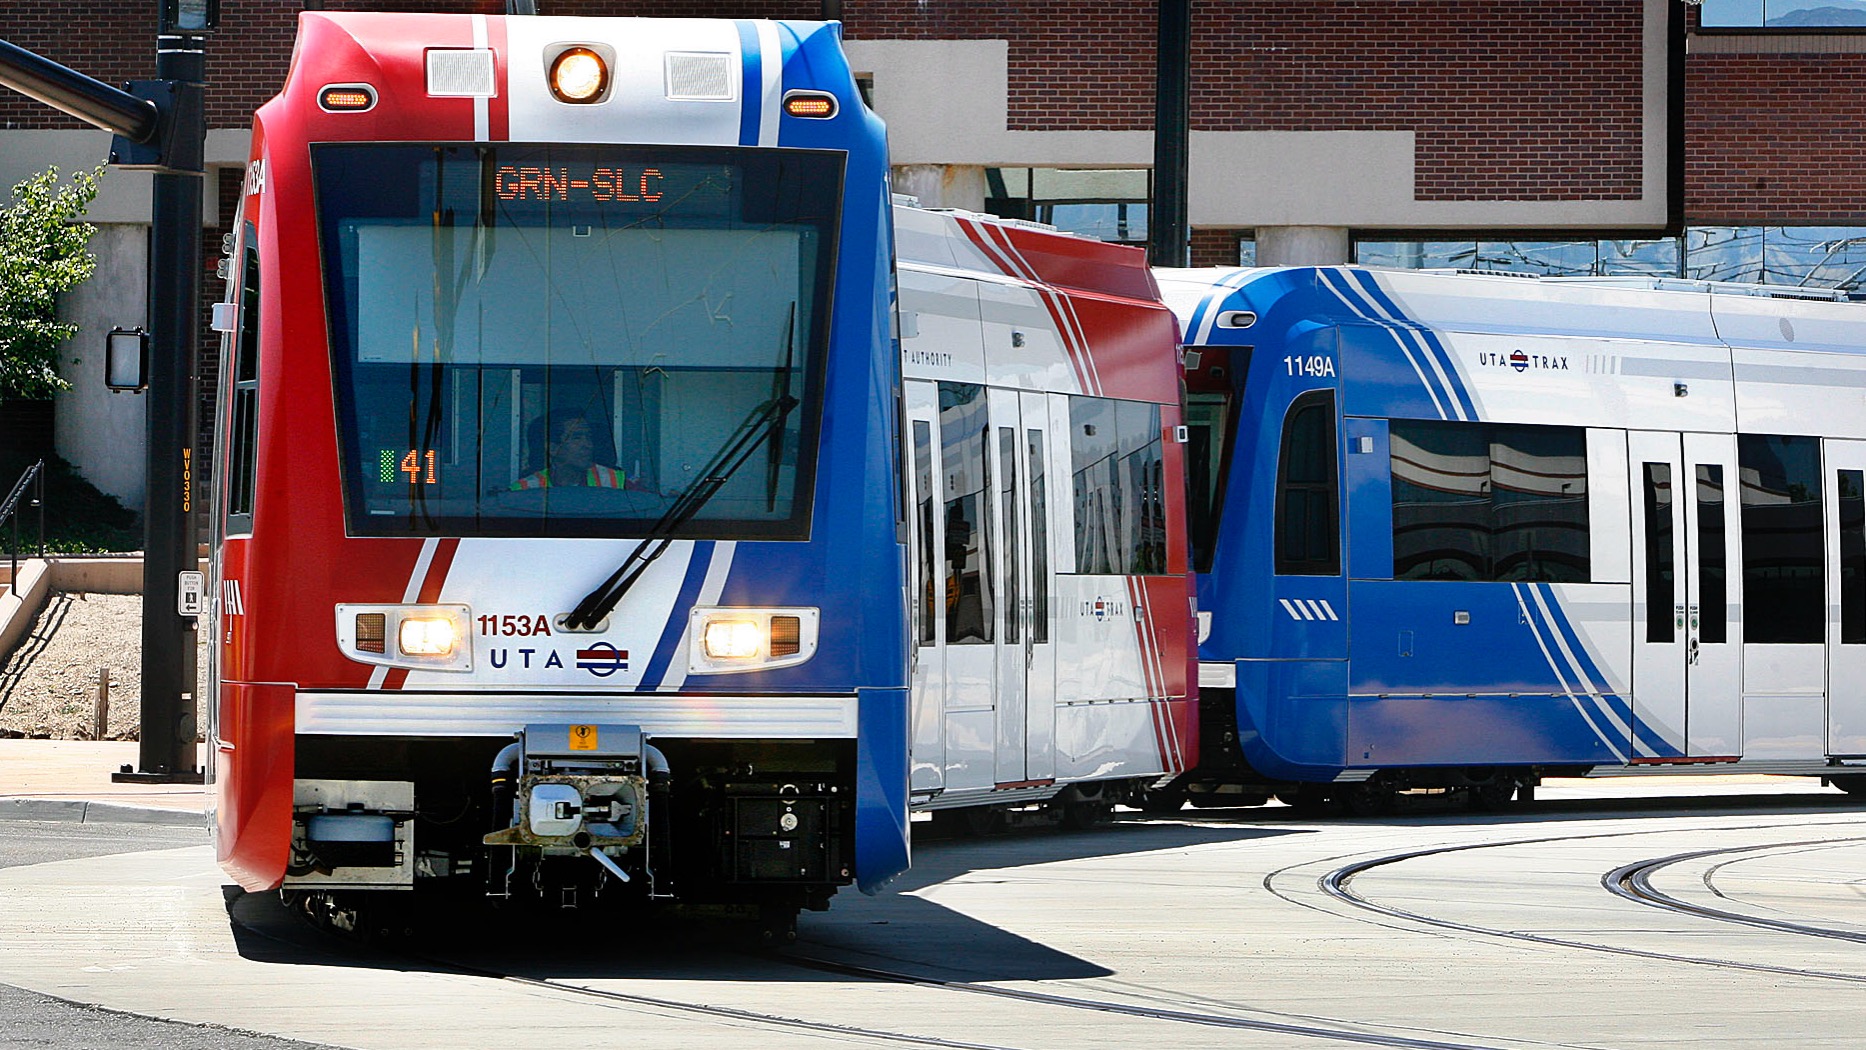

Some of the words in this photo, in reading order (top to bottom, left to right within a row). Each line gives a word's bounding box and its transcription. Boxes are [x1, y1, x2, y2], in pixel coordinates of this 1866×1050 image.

[495, 166, 664, 202] GRN-SLC
[911, 351, 952, 366] AUTHORITY
[1283, 355, 1336, 378] 1149A
[1480, 352, 1507, 367] UTA
[1532, 355, 1568, 370] TRAX
[401, 449, 436, 483] 41
[1080, 601, 1094, 616] UTA
[1106, 601, 1123, 616] TRAX
[477, 614, 551, 636] 1153A
[490, 648, 563, 669] UTA
